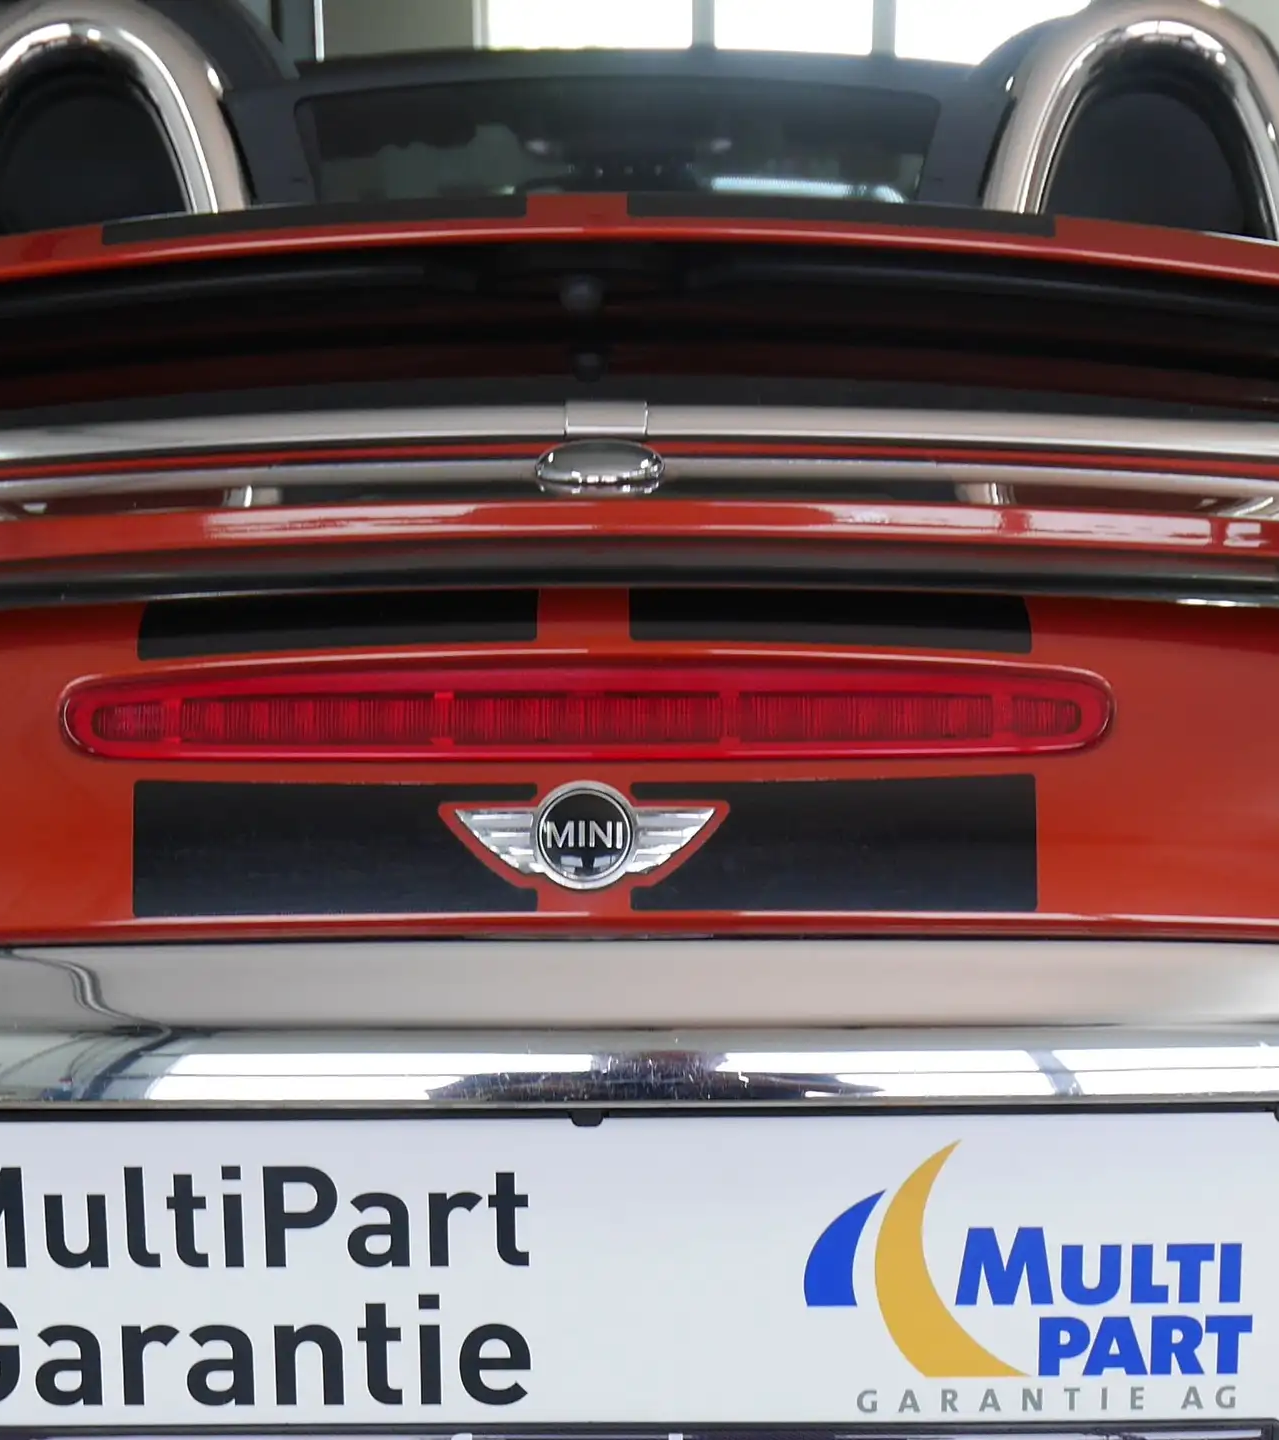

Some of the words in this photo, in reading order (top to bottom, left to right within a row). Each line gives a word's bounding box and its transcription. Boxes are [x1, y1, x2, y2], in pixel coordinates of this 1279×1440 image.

[544, 820, 624, 850] MINI
[1038, 1315, 1254, 1377] PART
[856, 1386, 1145, 1414] GARANTIE
[1181, 1384, 1237, 1411] AG
